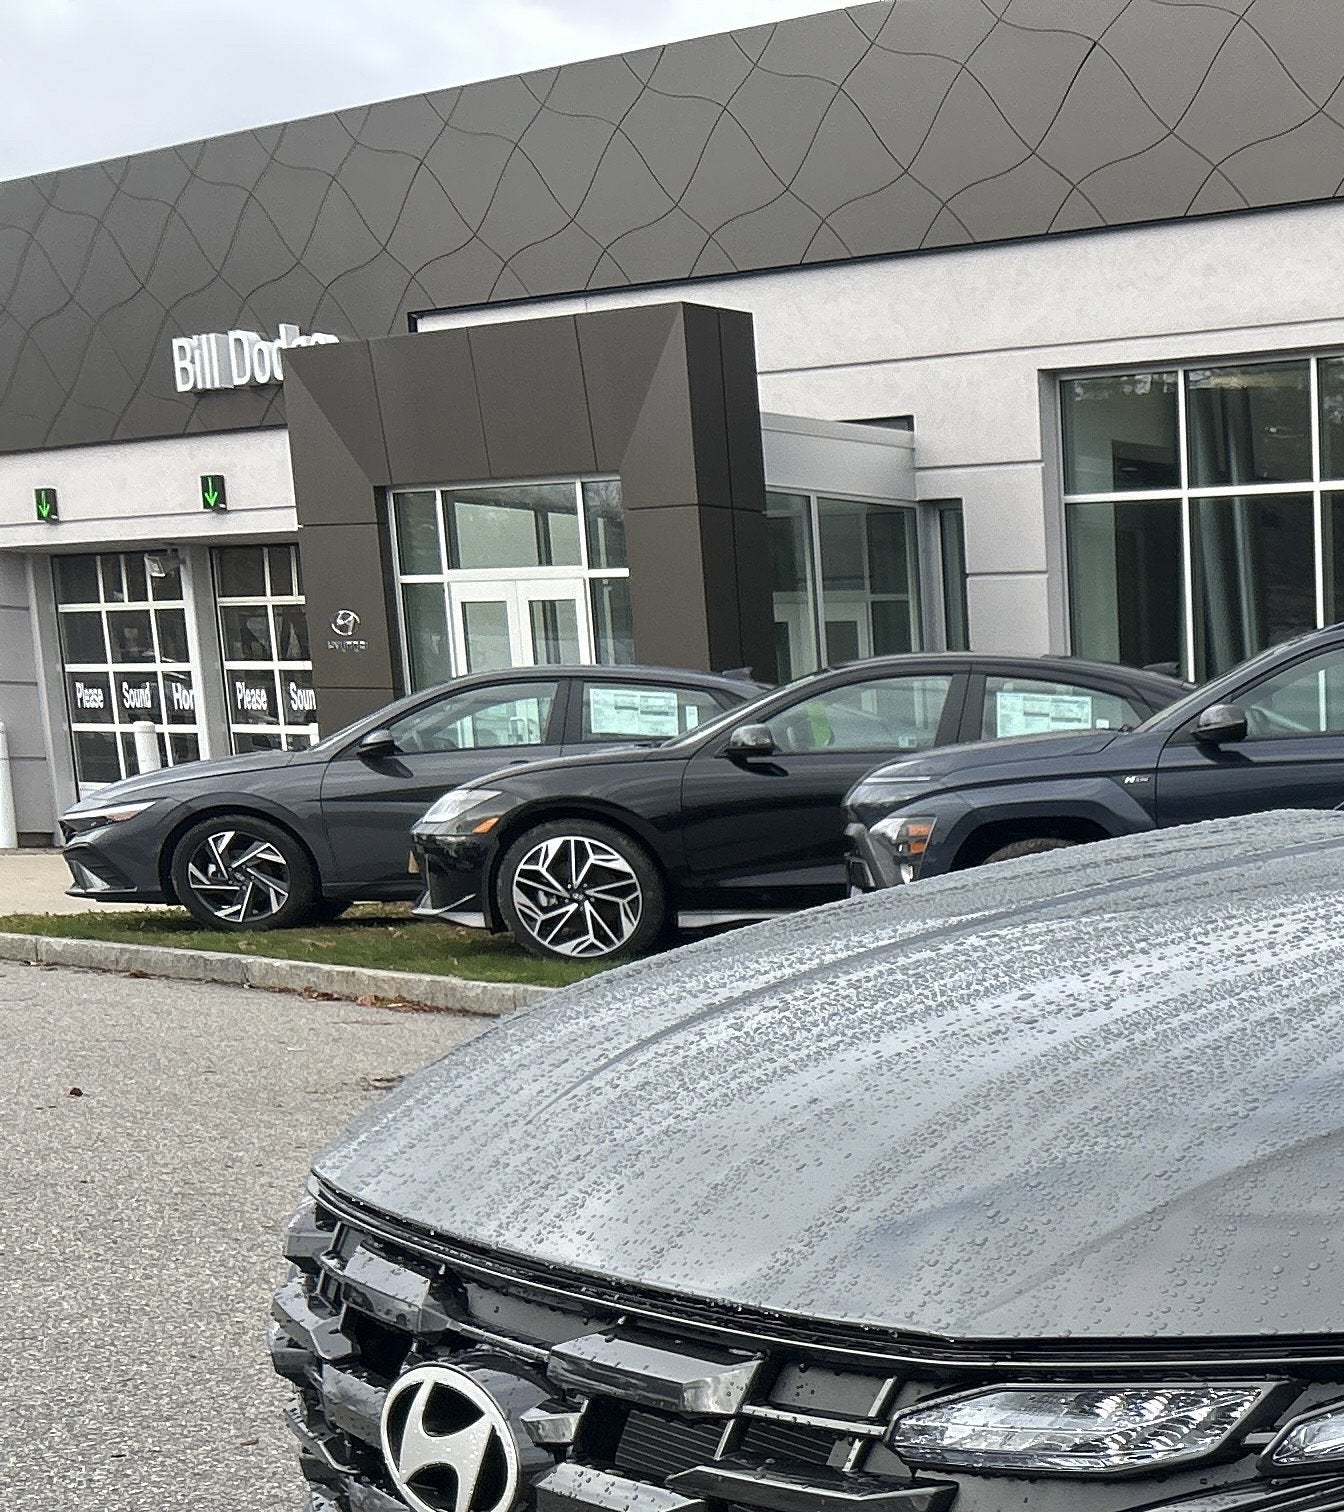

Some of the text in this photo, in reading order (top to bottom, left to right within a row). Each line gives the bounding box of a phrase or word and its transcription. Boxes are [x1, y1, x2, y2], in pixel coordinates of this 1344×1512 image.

[172, 334, 226, 392] Bill
[75, 681, 104, 709] Please
[122, 681, 152, 709] Sound
[235, 681, 317, 711] Please Soun
